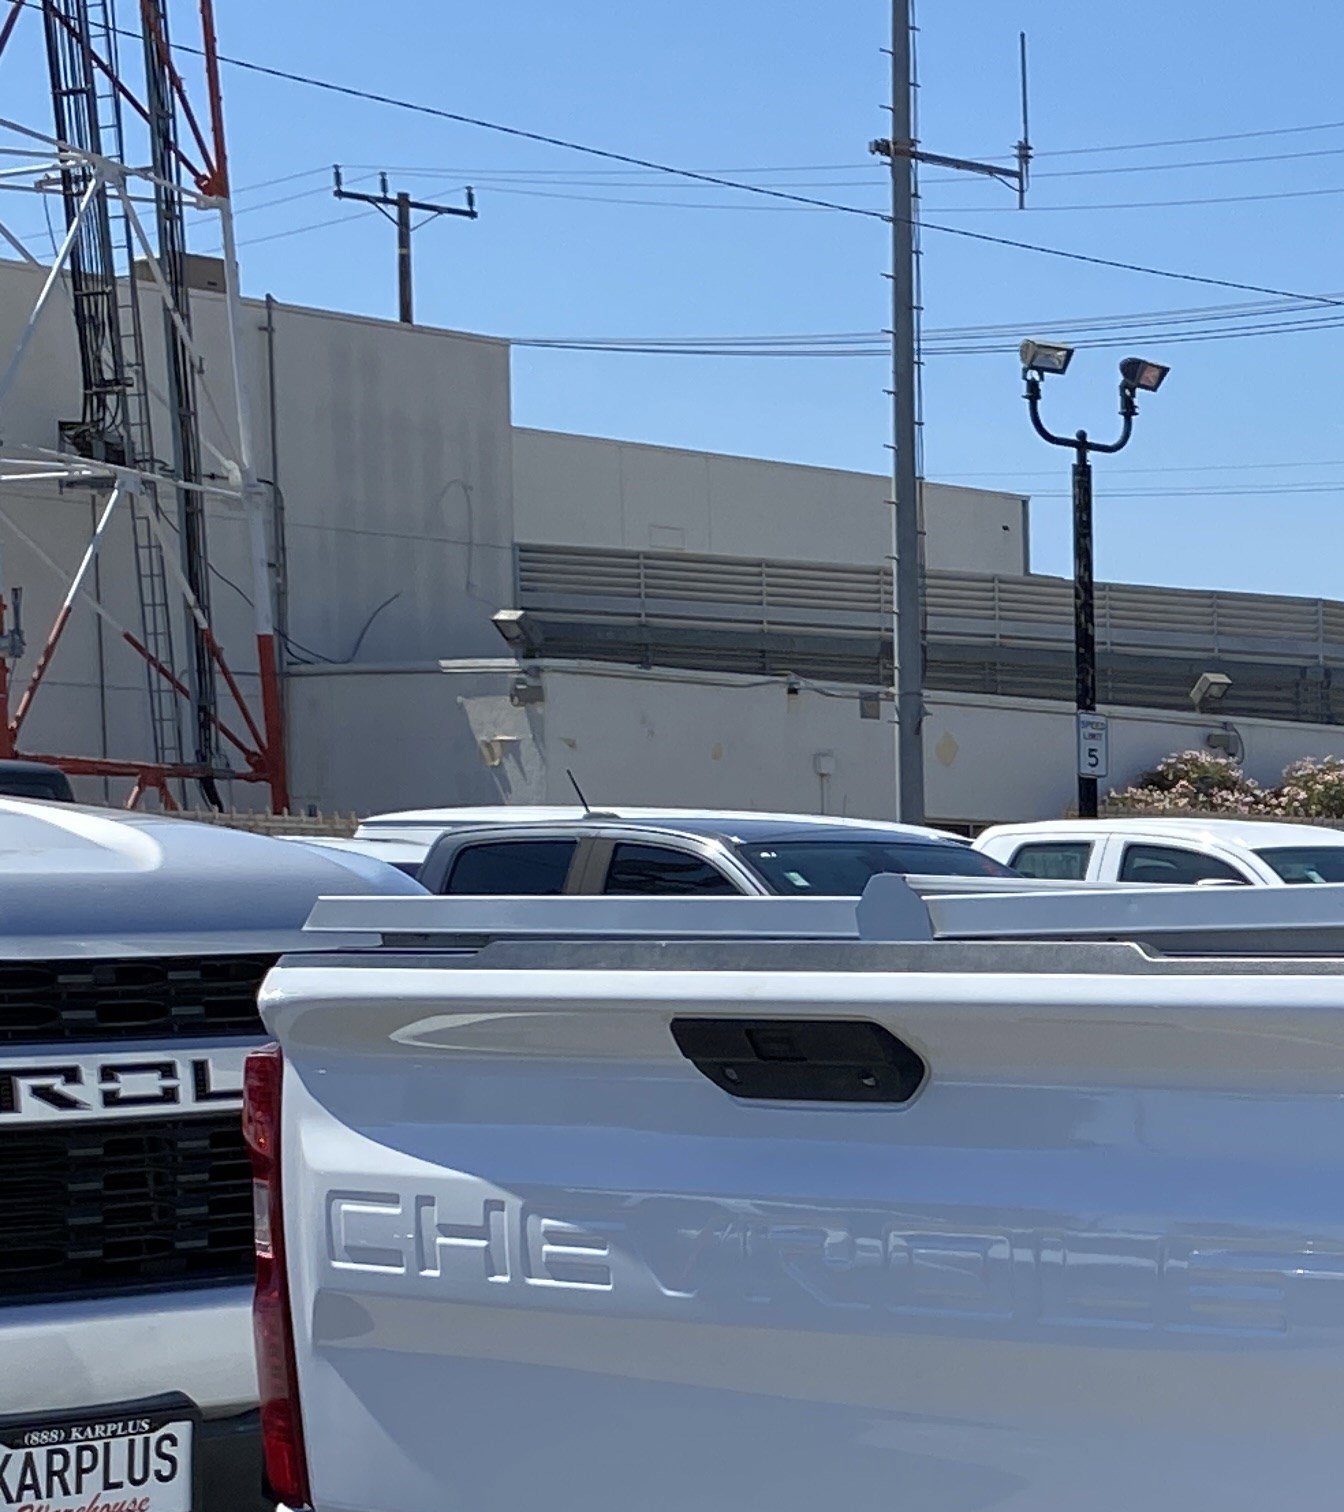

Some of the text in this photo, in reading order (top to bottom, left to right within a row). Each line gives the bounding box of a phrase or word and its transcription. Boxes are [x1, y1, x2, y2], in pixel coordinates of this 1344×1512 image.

[1088, 747, 1098, 767] 5
[24, 1418, 150, 1446] (888) KARPLUS
